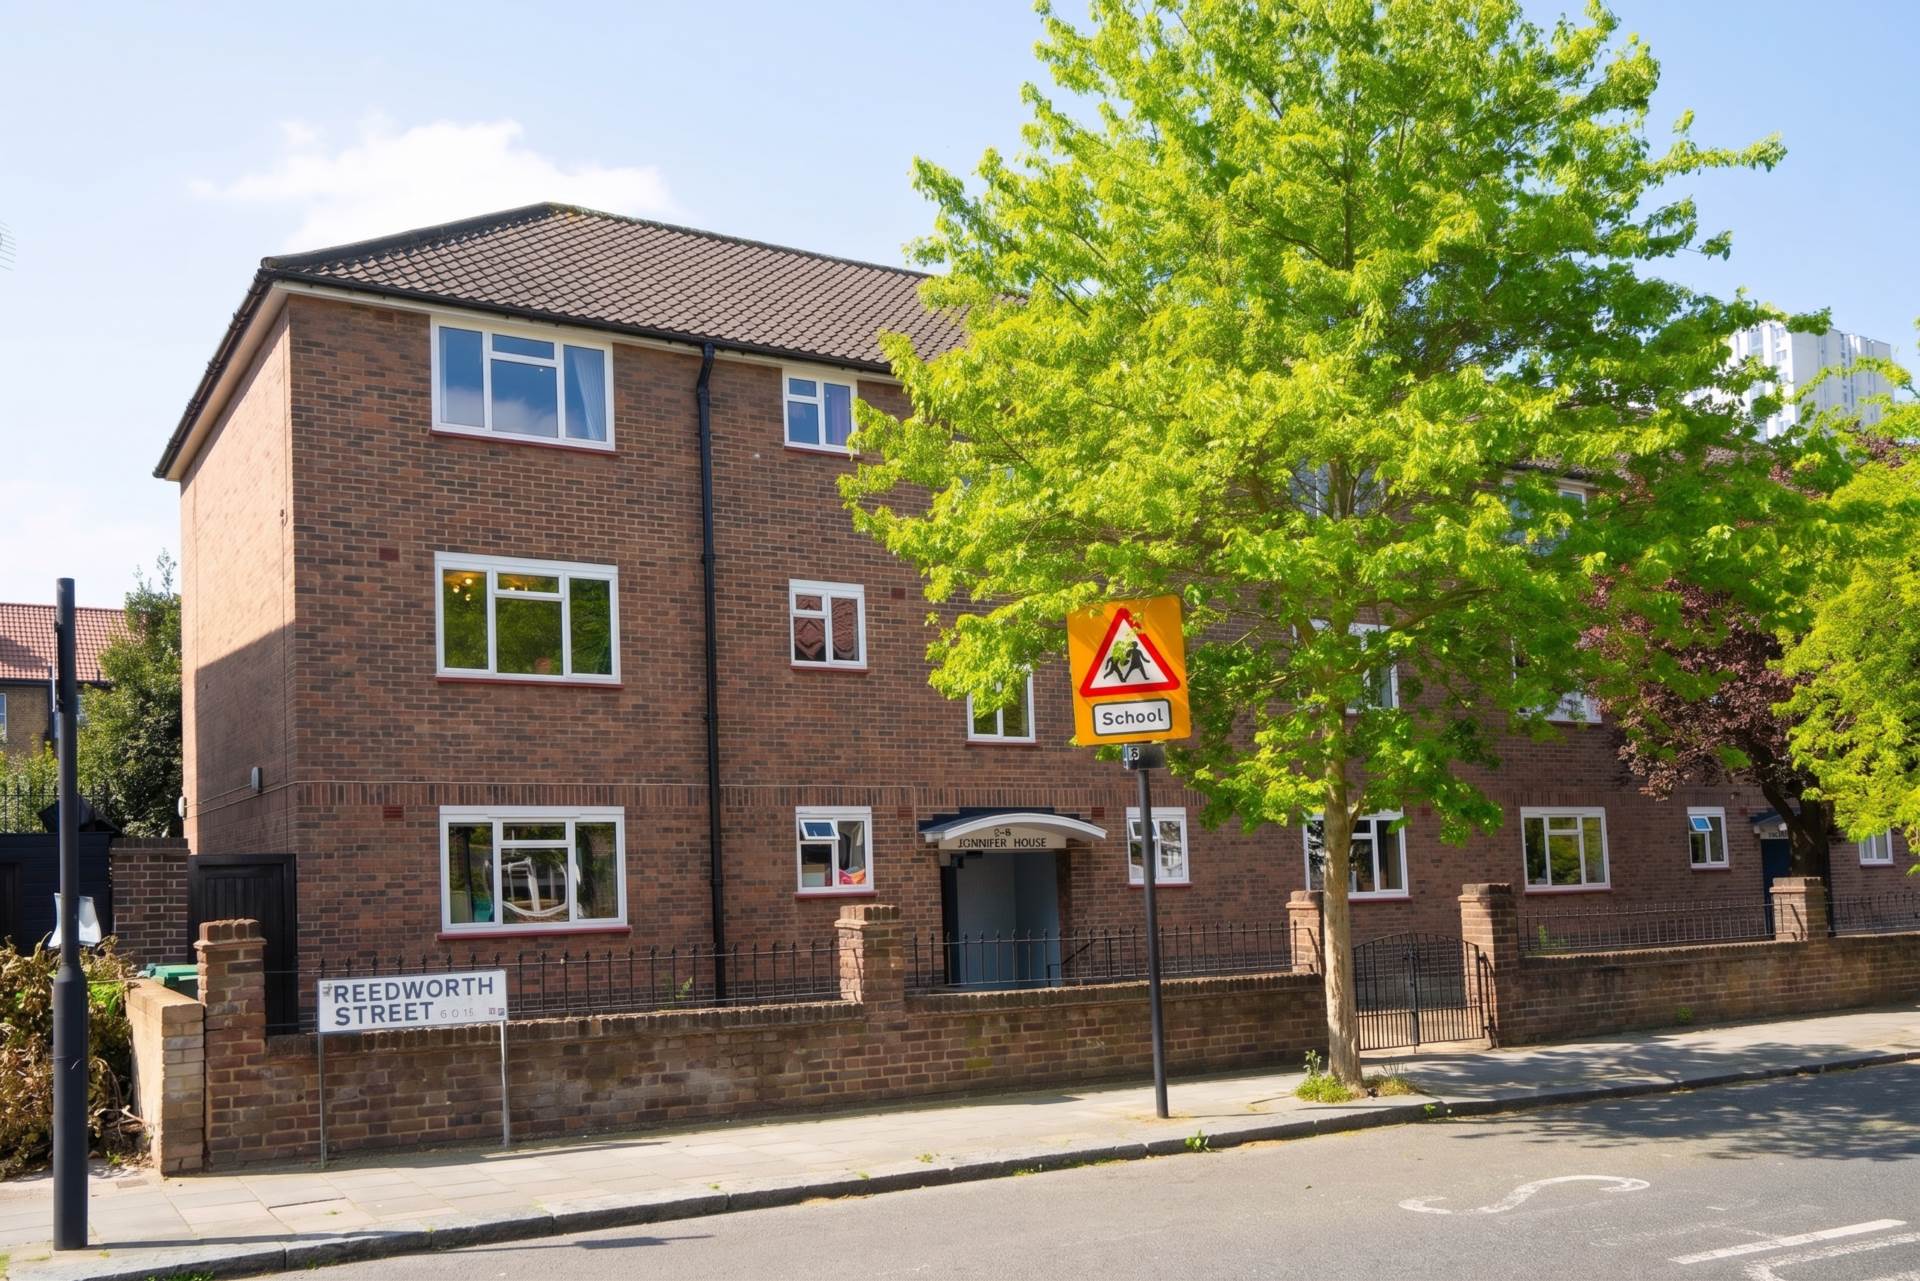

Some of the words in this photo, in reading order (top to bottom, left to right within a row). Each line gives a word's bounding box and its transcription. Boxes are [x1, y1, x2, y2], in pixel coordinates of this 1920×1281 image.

[1102, 708, 1164, 726] School
[1014, 837, 1047, 849] HOUSE
[333, 977, 494, 1004] REEDWORTH
[334, 1001, 434, 1026] STREET
